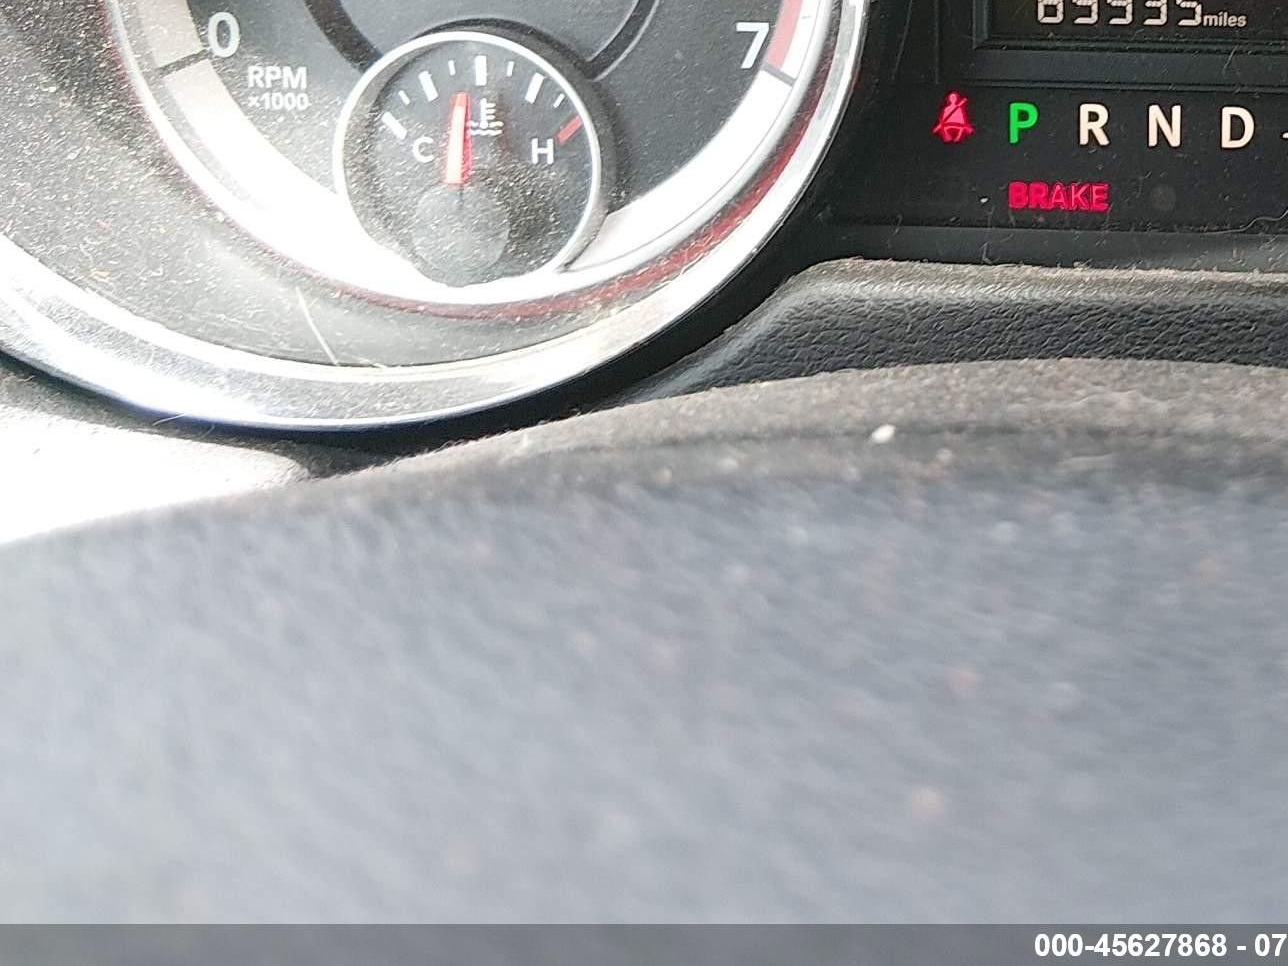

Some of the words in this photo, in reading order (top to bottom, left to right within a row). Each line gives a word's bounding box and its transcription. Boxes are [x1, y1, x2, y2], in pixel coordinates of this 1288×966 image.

[1203, 11, 1247, 28] miles
[207, 11, 240, 58] 0
[735, 22, 770, 69] 7
[247, 65, 308, 90] RPM
[1008, 102, 1039, 145] P
[1079, 103, 1110, 147] R
[1148, 104, 1182, 148] N
[1220, 105, 1255, 150] D
[412, 136, 434, 163] C
[531, 137, 555, 165] H
[1008, 181, 1110, 212] BRAKE
